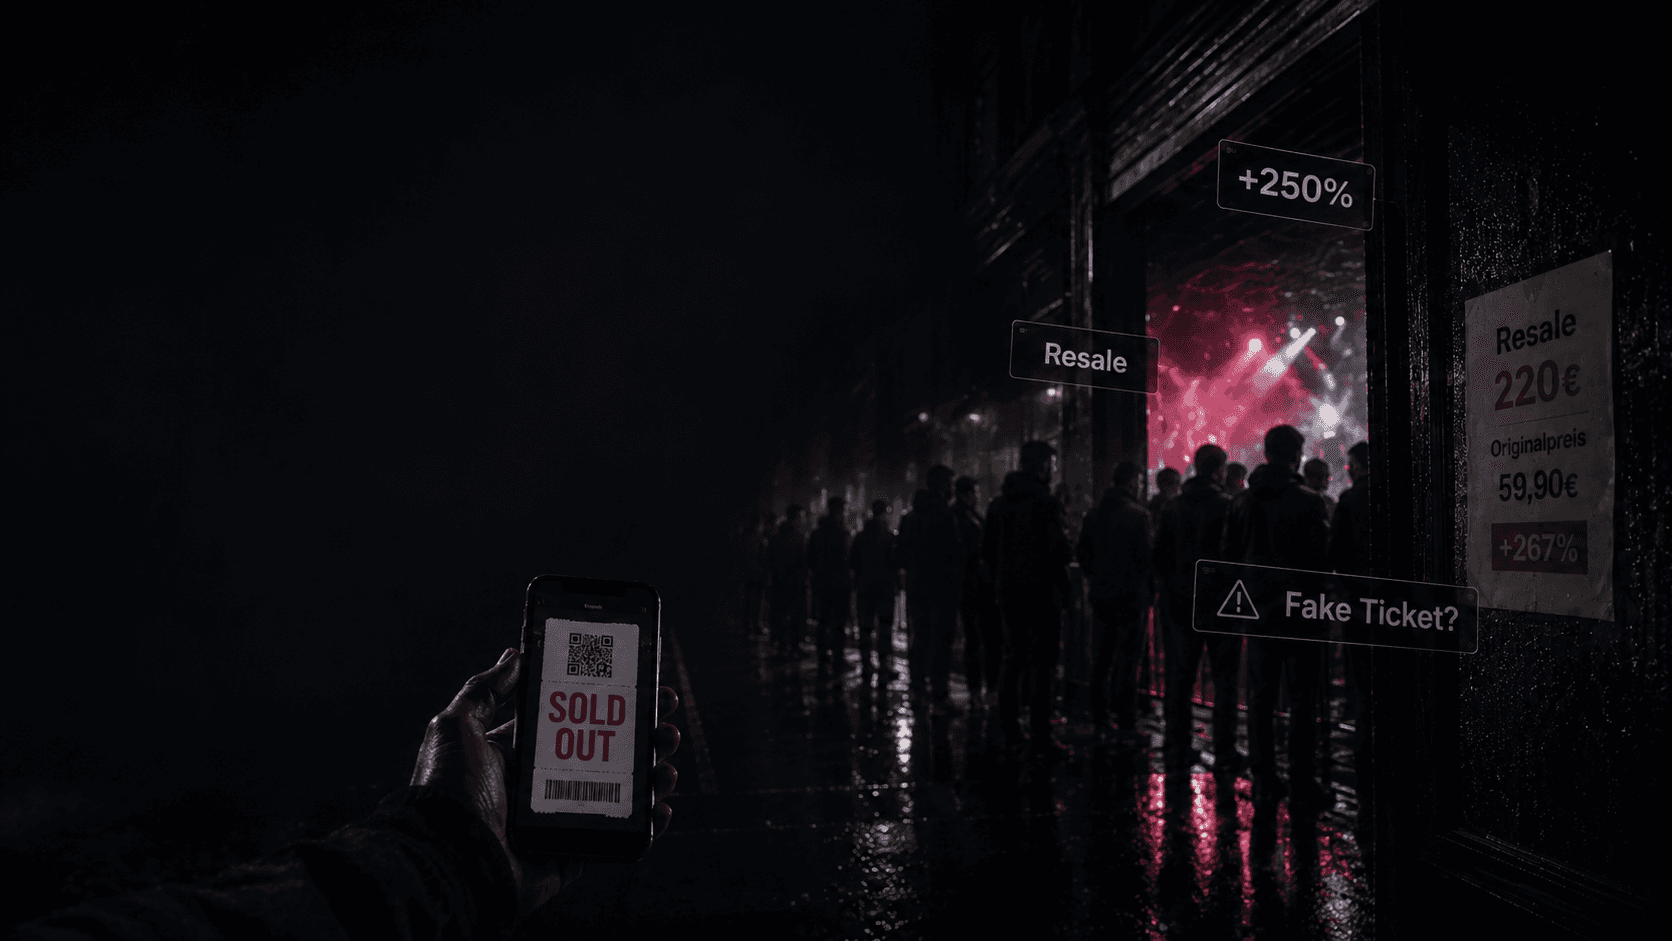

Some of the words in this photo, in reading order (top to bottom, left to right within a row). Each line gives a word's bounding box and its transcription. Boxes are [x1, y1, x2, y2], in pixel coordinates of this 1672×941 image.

[1496, 309, 1577, 356] Resale
[1494, 359, 1582, 412] 220€
[1491, 427, 1587, 460] Originalpreis
[1498, 468, 1579, 505] 59,90€
[1499, 532, 1579, 563] +267%
[548, 690, 626, 726] SOLD
[554, 727, 616, 762] OUT
